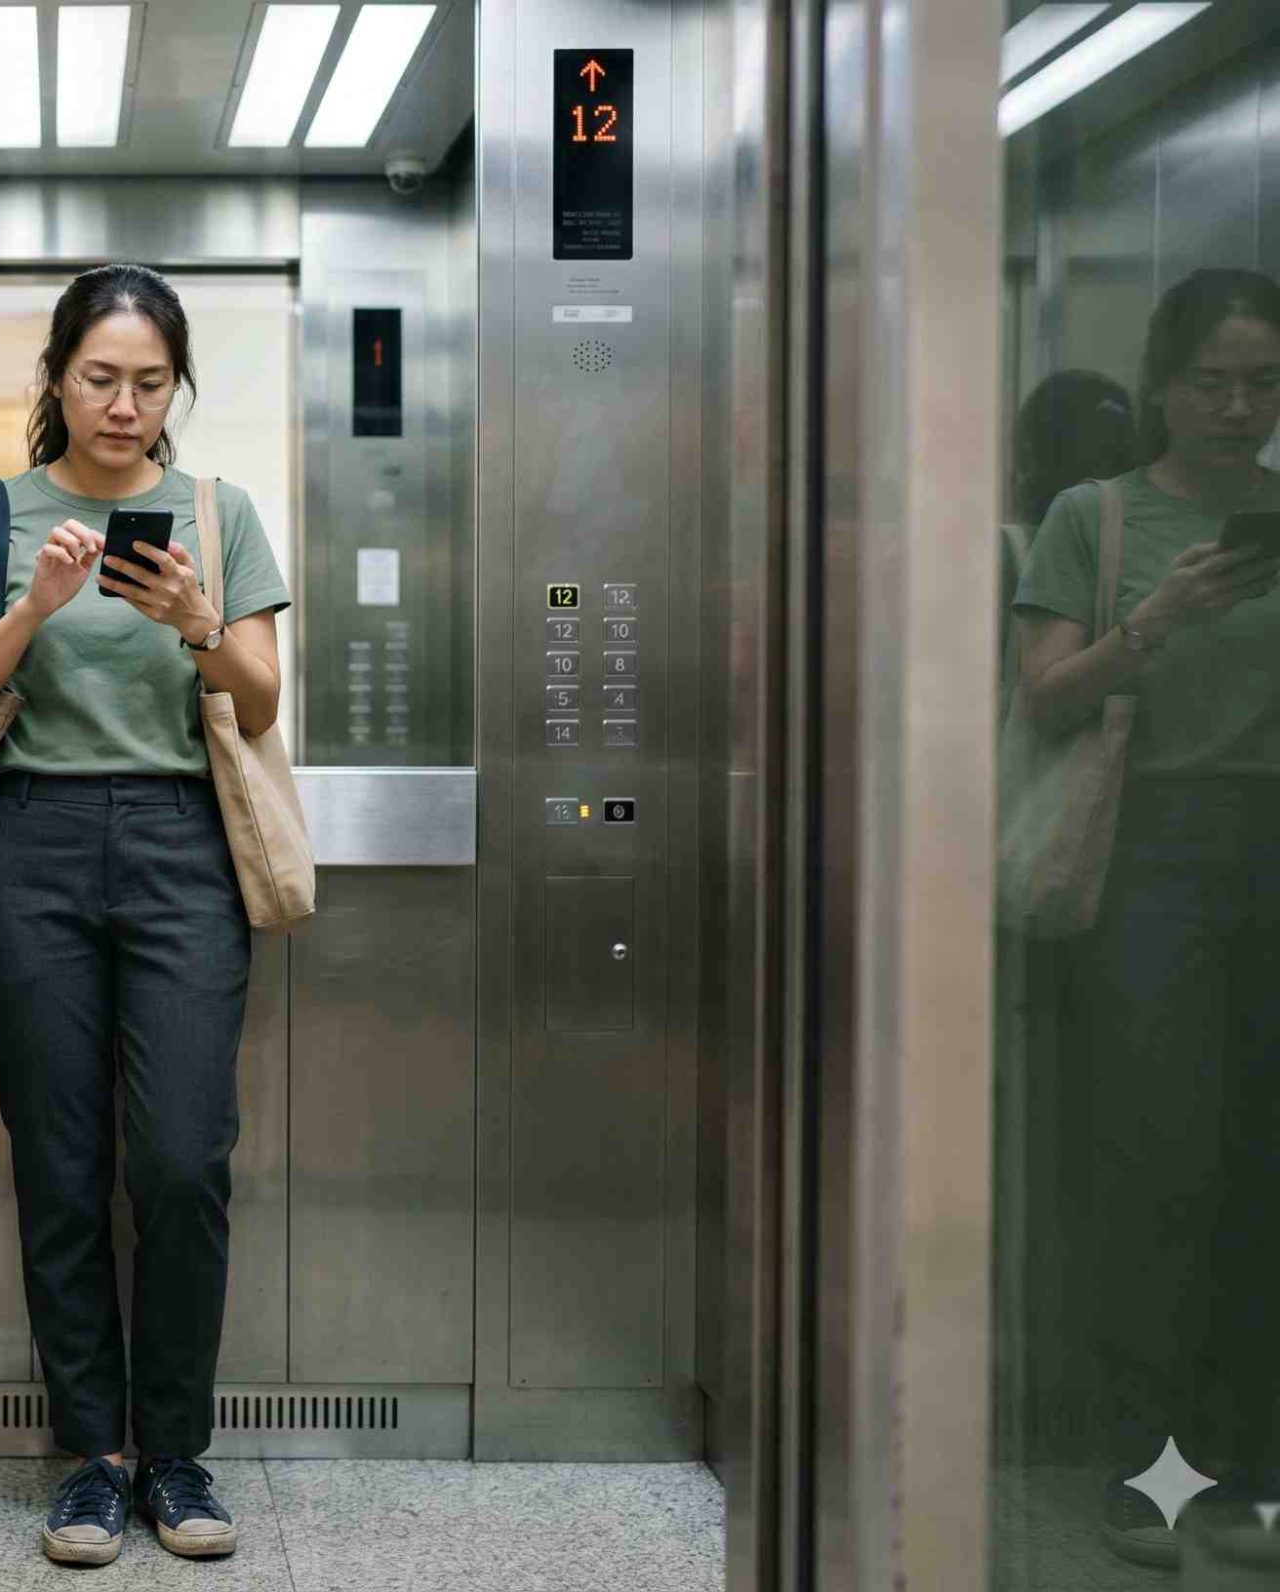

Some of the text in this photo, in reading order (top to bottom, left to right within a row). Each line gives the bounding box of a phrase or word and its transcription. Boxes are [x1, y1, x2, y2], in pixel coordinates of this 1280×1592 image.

[572, 105, 617, 141] 12
[556, 589, 572, 605] 12
[555, 623, 573, 638] 12
[611, 623, 629, 638] 10
[554, 657, 572, 673] 10
[615, 657, 625, 672] 8
[555, 727, 570, 740] 14
